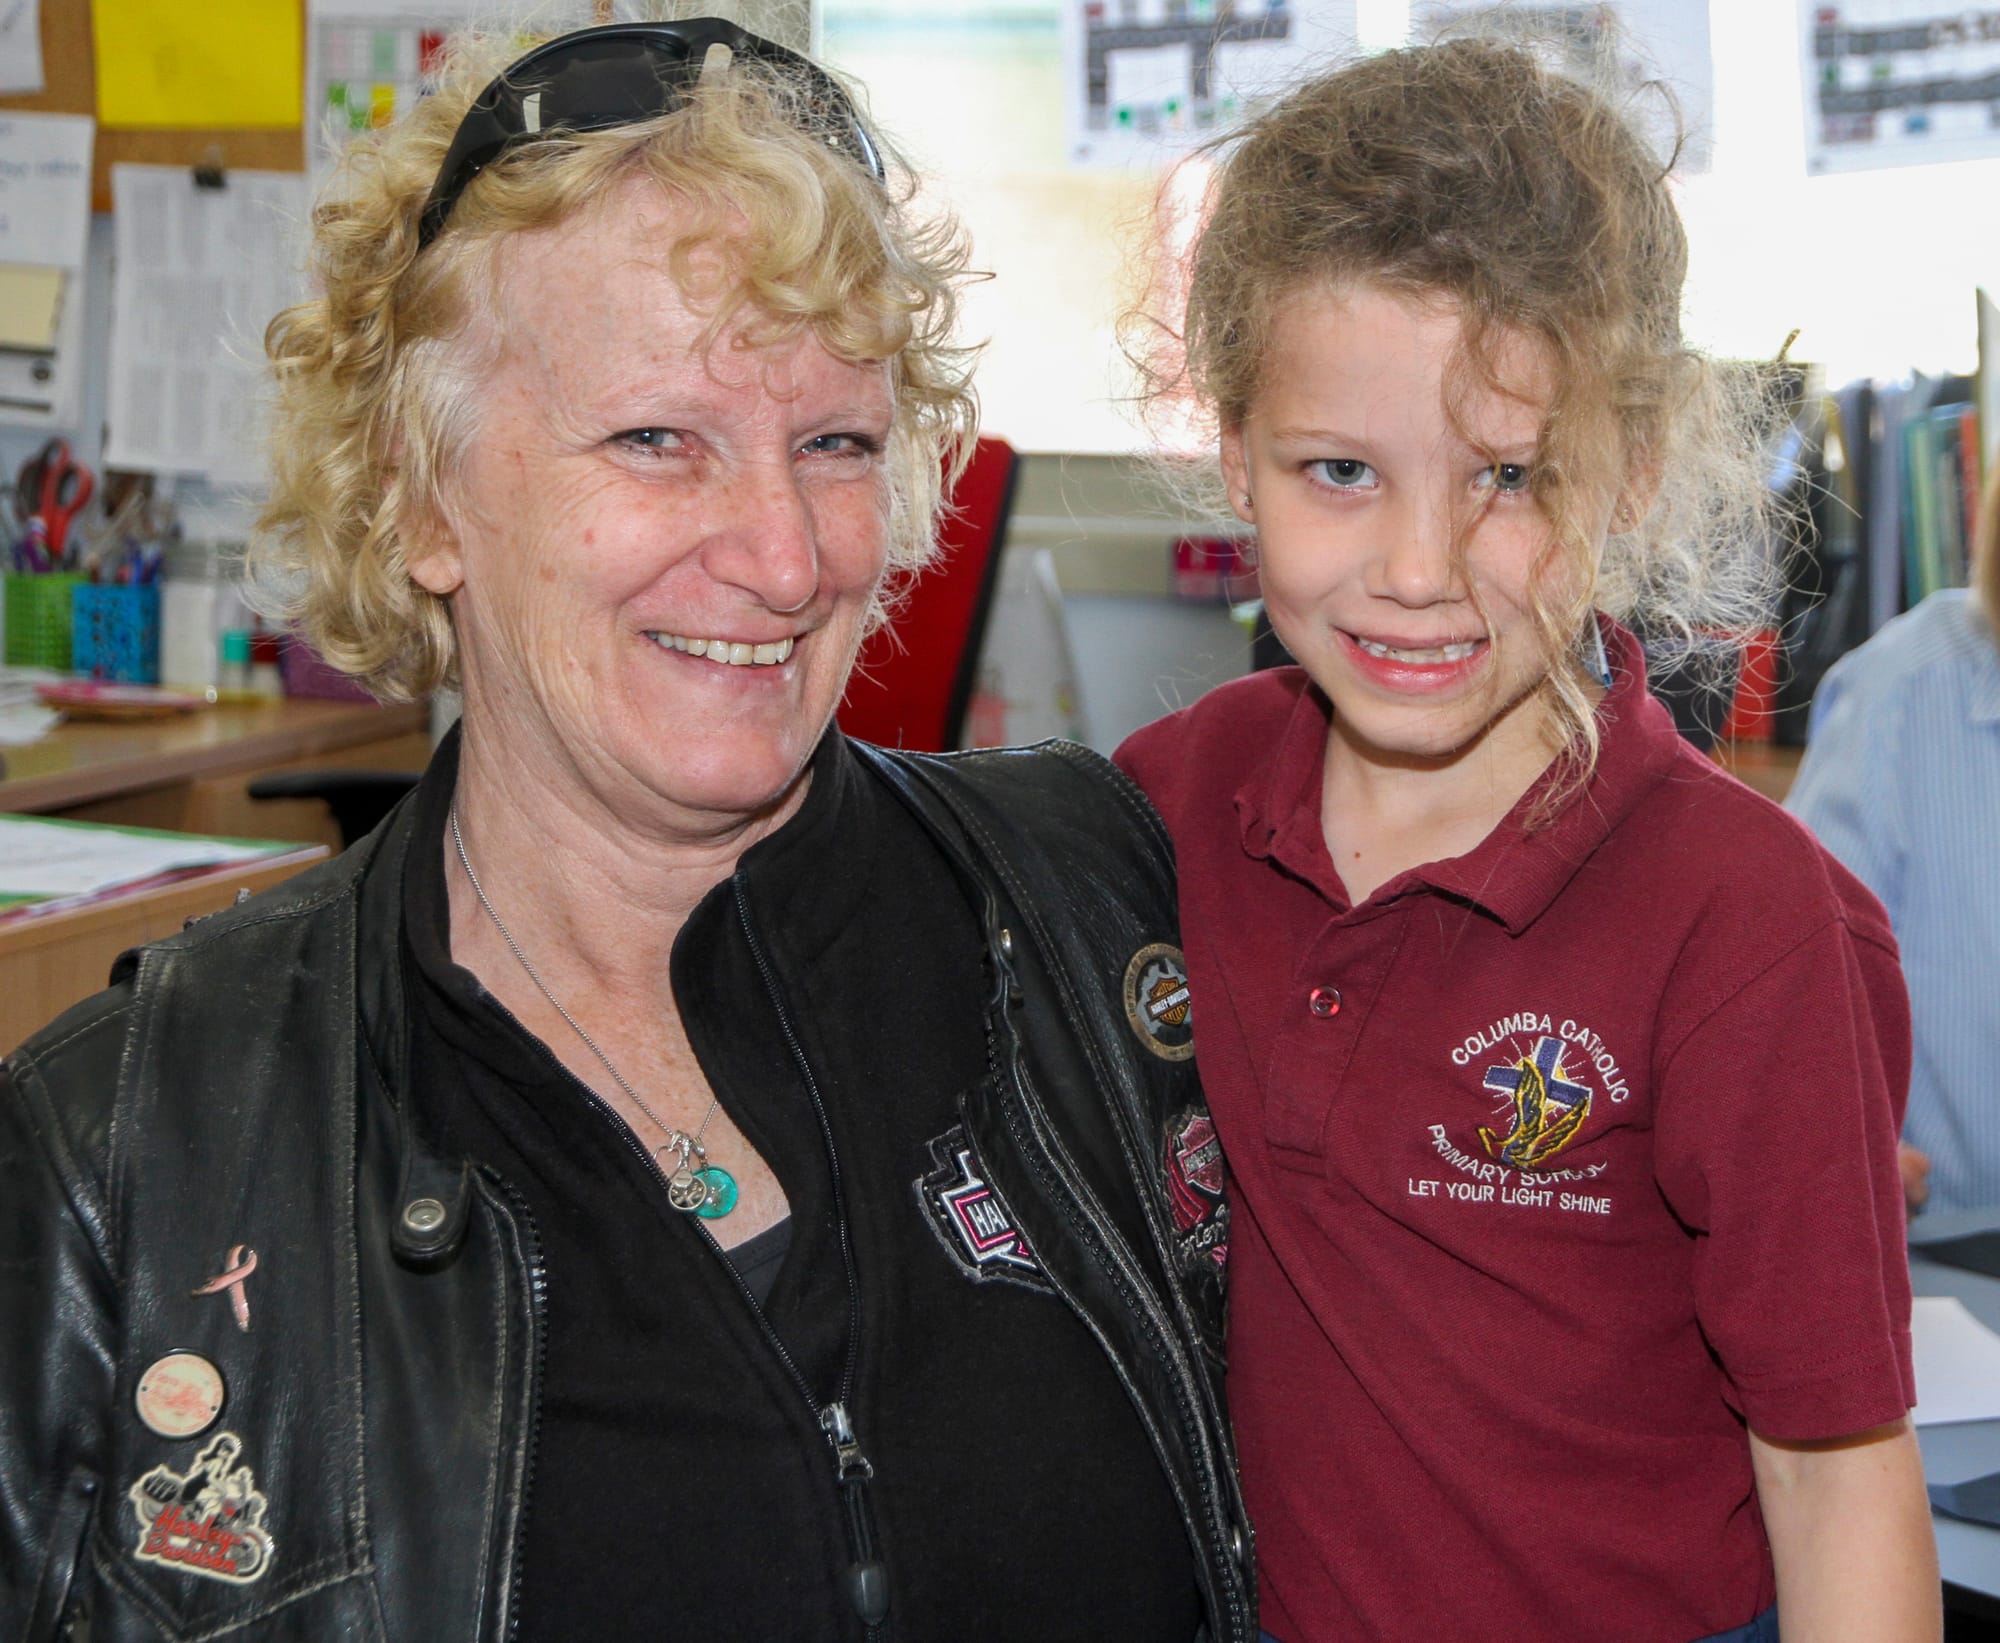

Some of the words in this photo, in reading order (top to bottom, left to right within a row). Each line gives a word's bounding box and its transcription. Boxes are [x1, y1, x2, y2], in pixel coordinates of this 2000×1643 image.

[1452, 1012, 1552, 1065] COLUMBA
[1559, 1019, 1630, 1104] CATHOLIC
[1427, 1123, 1511, 1185] PRIMARY
[1408, 1177, 1440, 1197] LET
[1446, 1182, 1495, 1202] YOUR
[1501, 1186, 1553, 1207] LIGHT
[1559, 1192, 1612, 1214] SHINE
